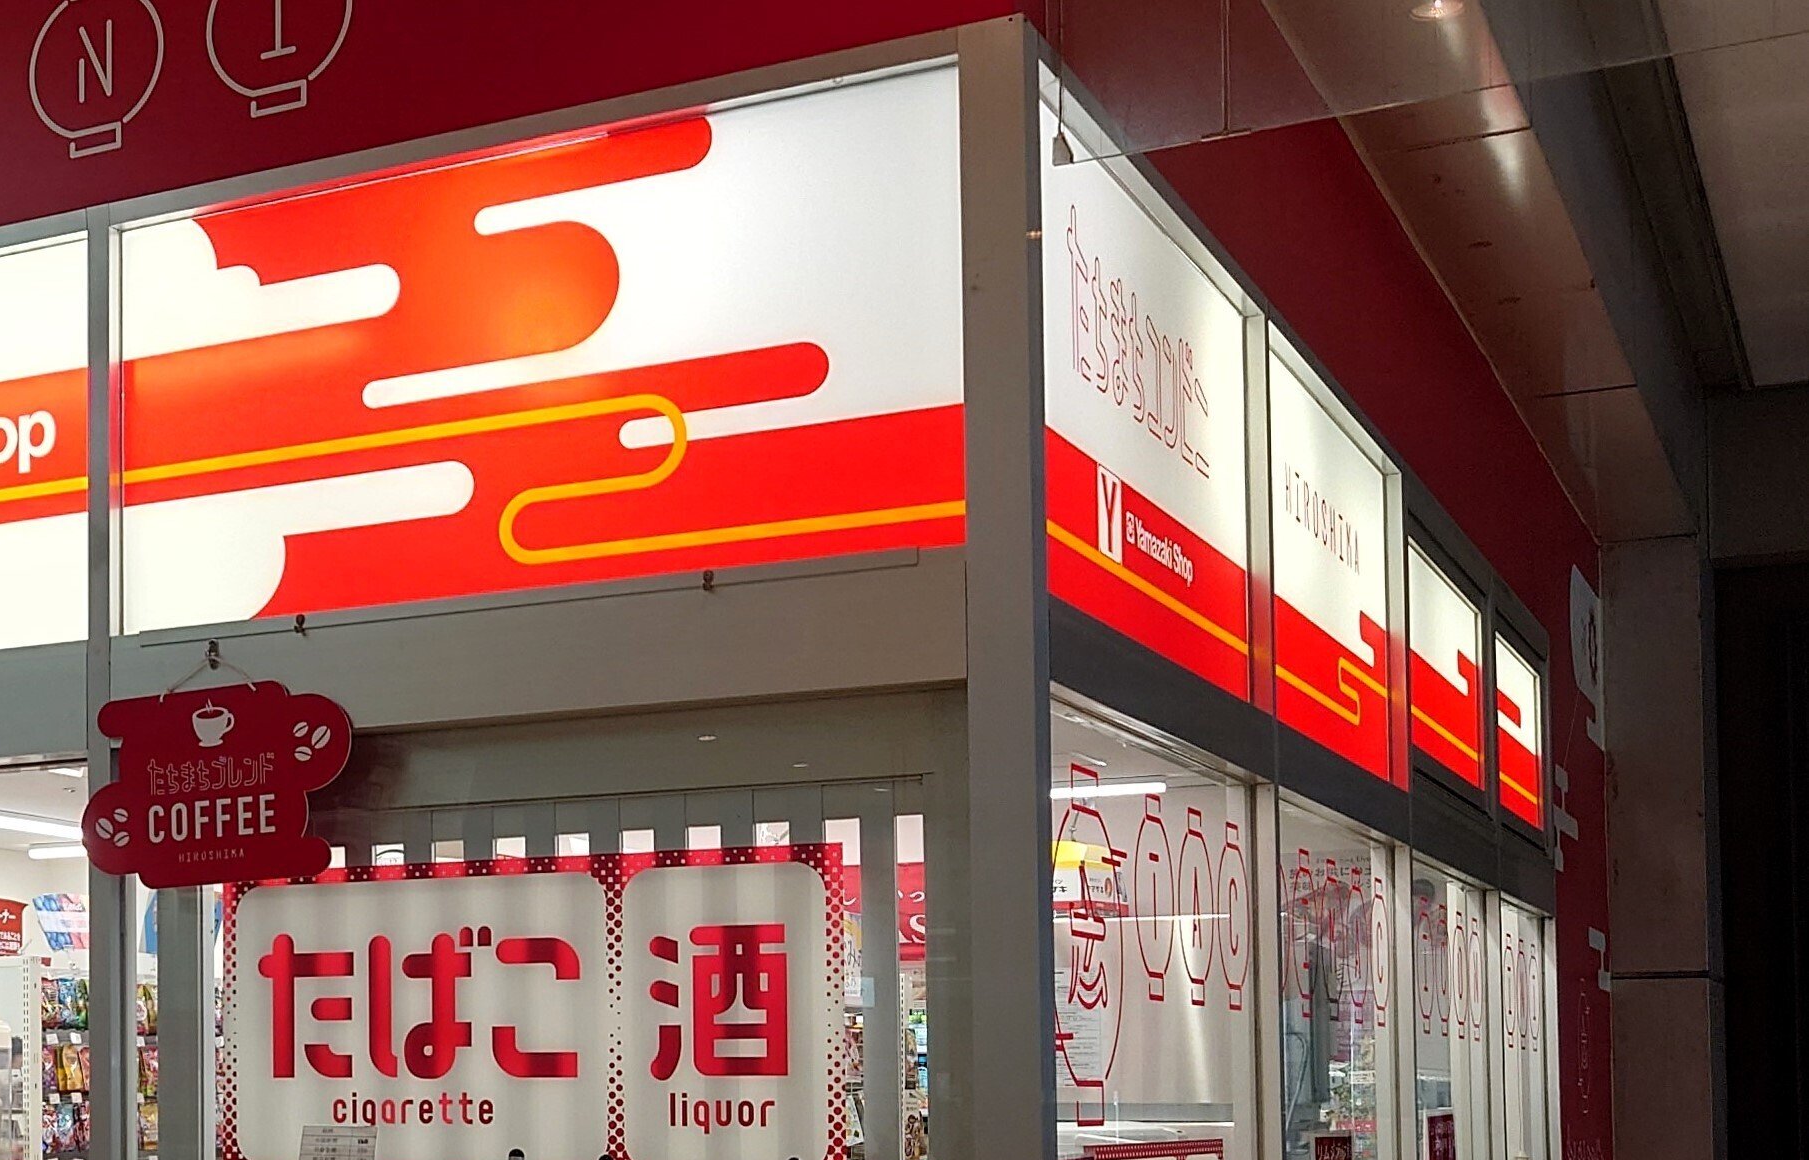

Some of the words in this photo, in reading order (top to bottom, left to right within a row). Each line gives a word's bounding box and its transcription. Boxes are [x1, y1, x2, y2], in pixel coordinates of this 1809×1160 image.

[1285, 462, 1360, 576] HIROSHIMA
[1133, 514, 1172, 570] Yamazaki
[1172, 538, 1193, 589] Shop
[147, 753, 275, 797] たちまちブレンド
[148, 793, 276, 844] COFFEE
[179, 848, 245, 864] HIROSHIMA
[258, 925, 580, 1080] たばこ
[649, 924, 788, 1081] 酒
[332, 1090, 493, 1126] cigarette
[668, 1092, 776, 1134] liquor
